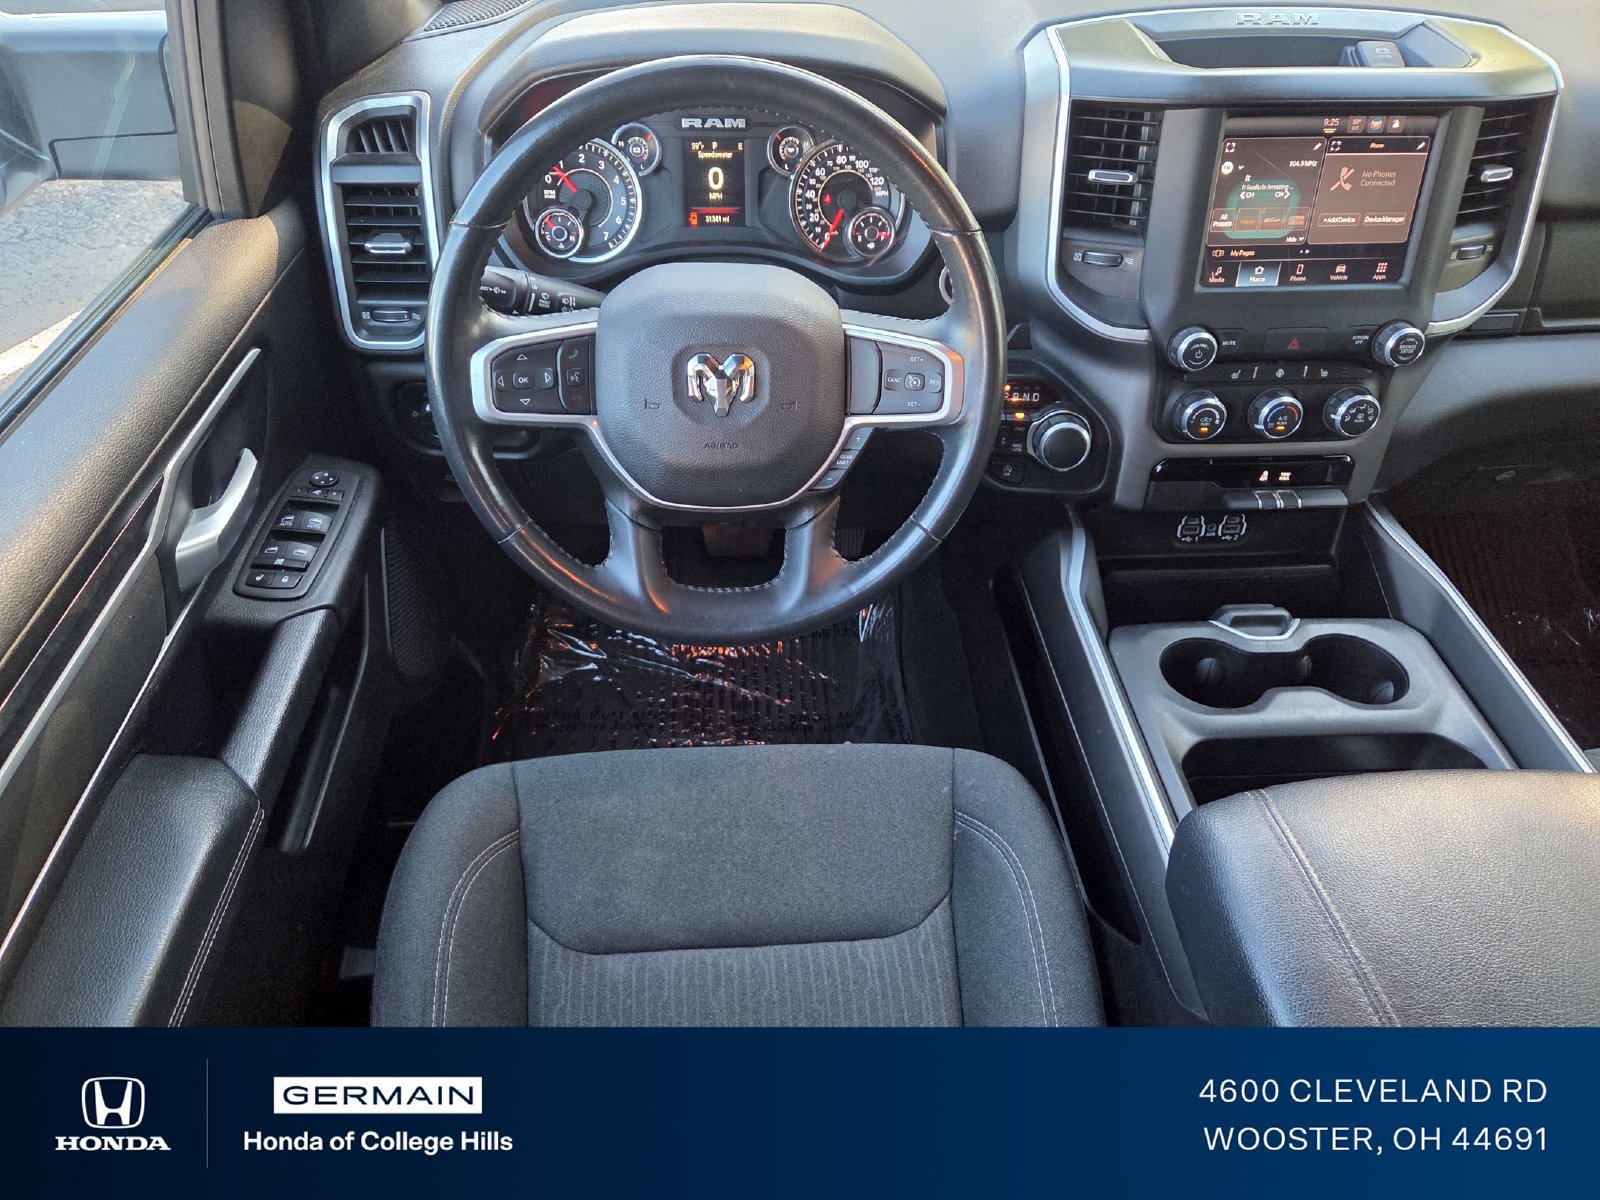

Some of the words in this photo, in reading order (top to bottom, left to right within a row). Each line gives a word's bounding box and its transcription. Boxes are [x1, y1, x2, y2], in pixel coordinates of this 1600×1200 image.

[1235, 12, 1318, 25] RAM
[681, 118, 746, 128] RAM
[1324, 118, 1340, 126] 9:25
[712, 142, 718, 150] P
[578, 153, 585, 163] 2
[698, 151, 733, 159] Speedometer
[836, 156, 847, 164] 80
[855, 160, 869, 168] 100
[598, 160, 605, 169] 3
[815, 168, 825, 176] 60
[1362, 170, 1372, 178] No
[1373, 170, 1397, 178] Phones
[545, 174, 552, 184] 0
[614, 175, 620, 184] 4
[708, 167, 723, 190] 0
[870, 177, 884, 185] 120
[1360, 179, 1396, 187] Connected
[709, 192, 722, 200] MPH
[805, 190, 815, 198] 40
[621, 197, 627, 205] 5
[616, 216, 621, 224] 6
[809, 213, 819, 222] 20
[1381, 216, 1405, 224] Manager
[603, 232, 609, 241] 7
[1023, 393, 1029, 401] N
[1032, 393, 1039, 402] D
[704, 442, 740, 450] AIRBAG
